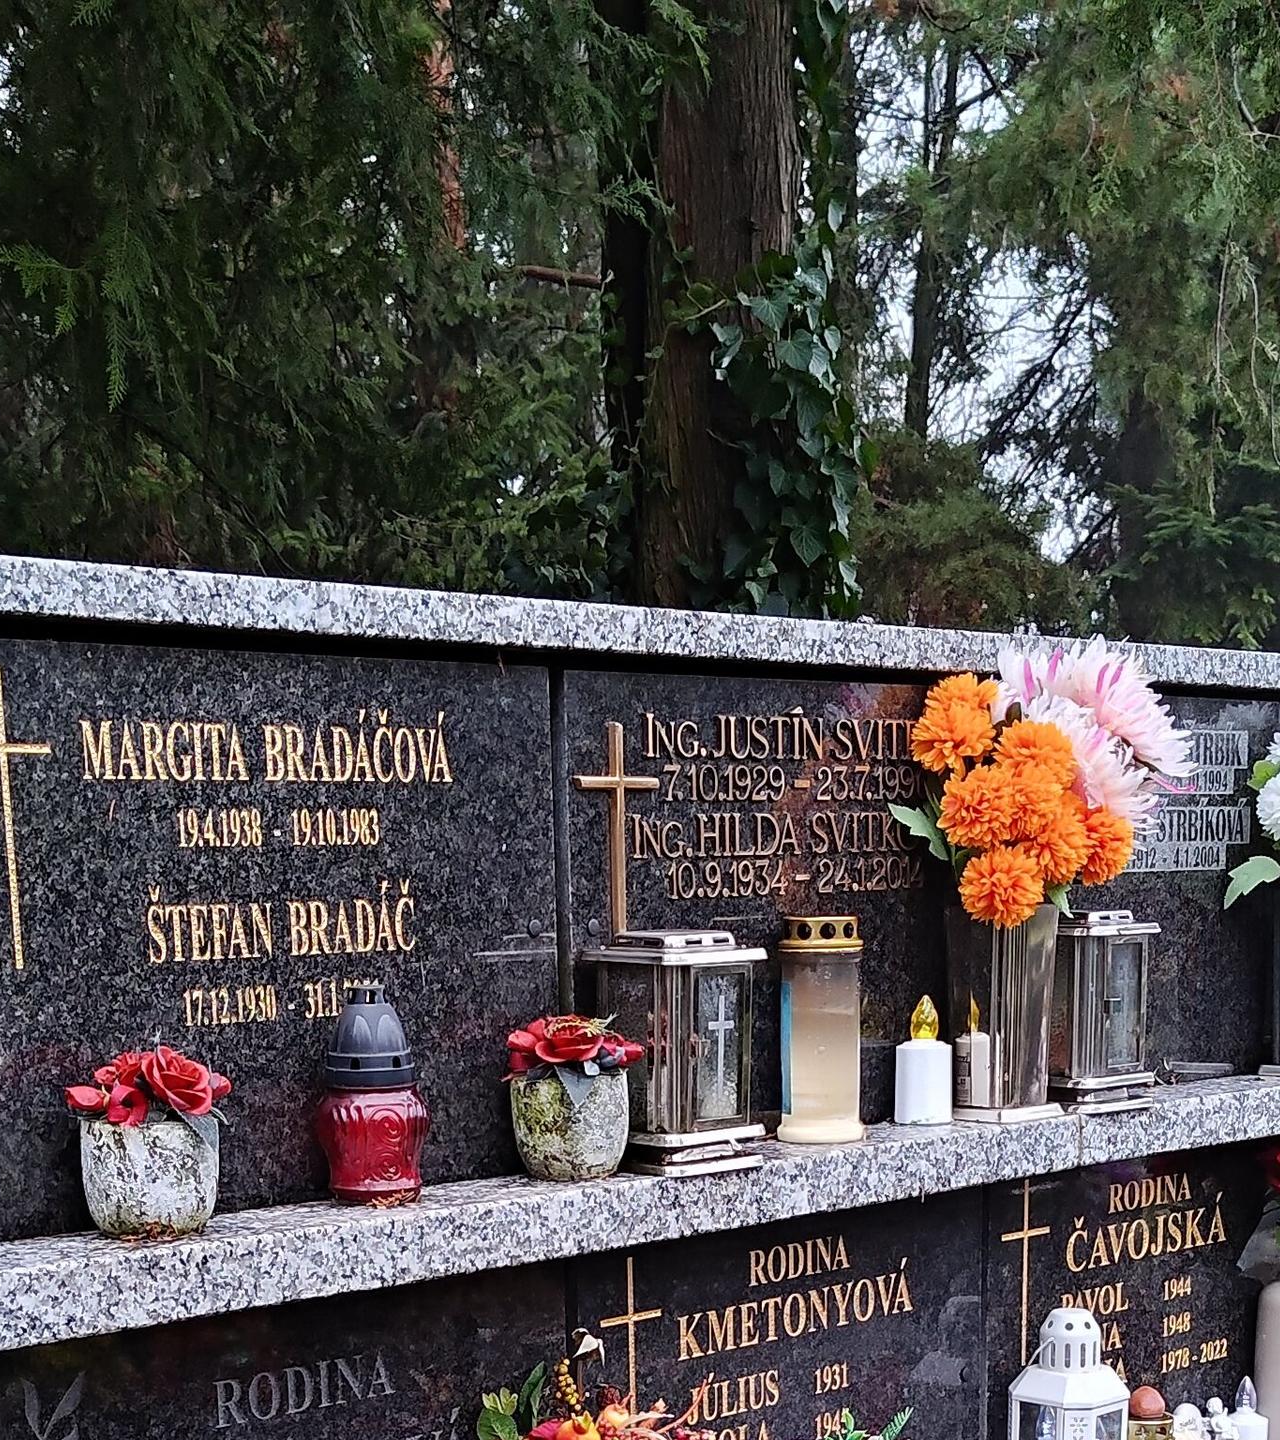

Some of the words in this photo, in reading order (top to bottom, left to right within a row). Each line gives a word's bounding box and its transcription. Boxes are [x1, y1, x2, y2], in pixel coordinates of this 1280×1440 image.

[79, 718, 250, 784] MARGITA
[264, 709, 453, 784] BRADÁČOVÁ
[712, 706, 823, 760] JUSTÍN
[833, 717, 918, 761] SVIT
[662, 765, 786, 802] 7.10.1929
[177, 809, 264, 848] 19.4.1938
[291, 808, 380, 847] 19.10.1983
[697, 811, 801, 857] HILDA
[666, 857, 789, 900] 10.9.1934
[147, 884, 274, 964] ŠTEFAN
[289, 878, 417, 957] BRADÁČ
[184, 984, 278, 1028] 17.12.1930
[1107, 1171, 1193, 1215] RODINA
[1065, 1191, 1228, 1274] ČAVOJSKÁ
[748, 1234, 851, 1288] RODINA
[677, 1257, 915, 1362] KMETONYOVÁ
[1163, 1275, 1193, 1302] 1944
[1162, 1311, 1192, 1338] 1948
[1160, 1346, 1191, 1375] 1978
[1199, 1338, 1228, 1364] 2022
[212, 1351, 397, 1430] RODINA
[686, 1370, 780, 1427] JÚLIUS
[814, 1361, 850, 1395] 1931
